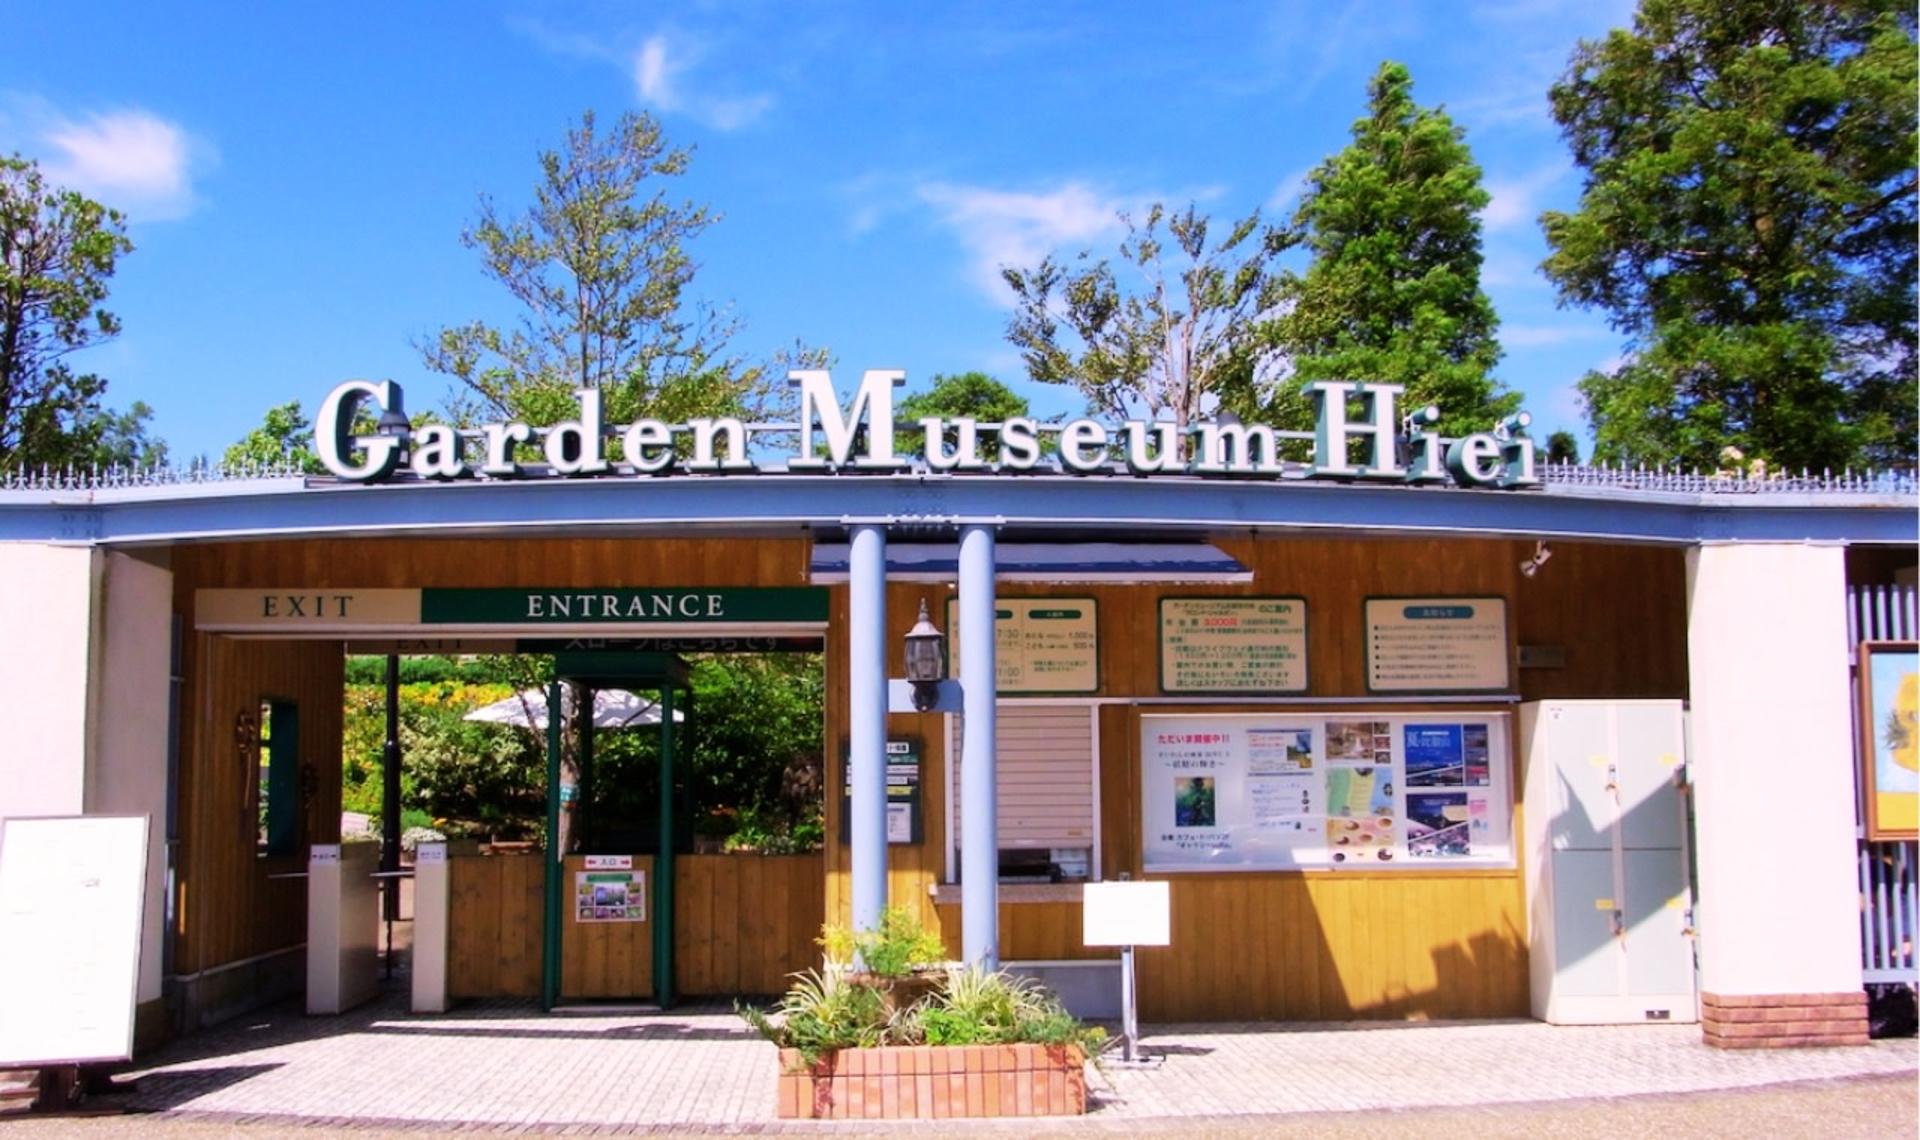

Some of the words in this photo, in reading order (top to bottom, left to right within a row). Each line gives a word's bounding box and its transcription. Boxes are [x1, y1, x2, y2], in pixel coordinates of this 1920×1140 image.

[314, 379, 754, 481] Garden
[788, 369, 1285, 476] Museum
[1302, 380, 1541, 487] Hiei
[262, 595, 354, 617] EXIT
[527, 594, 725, 617] ENTRANCE
